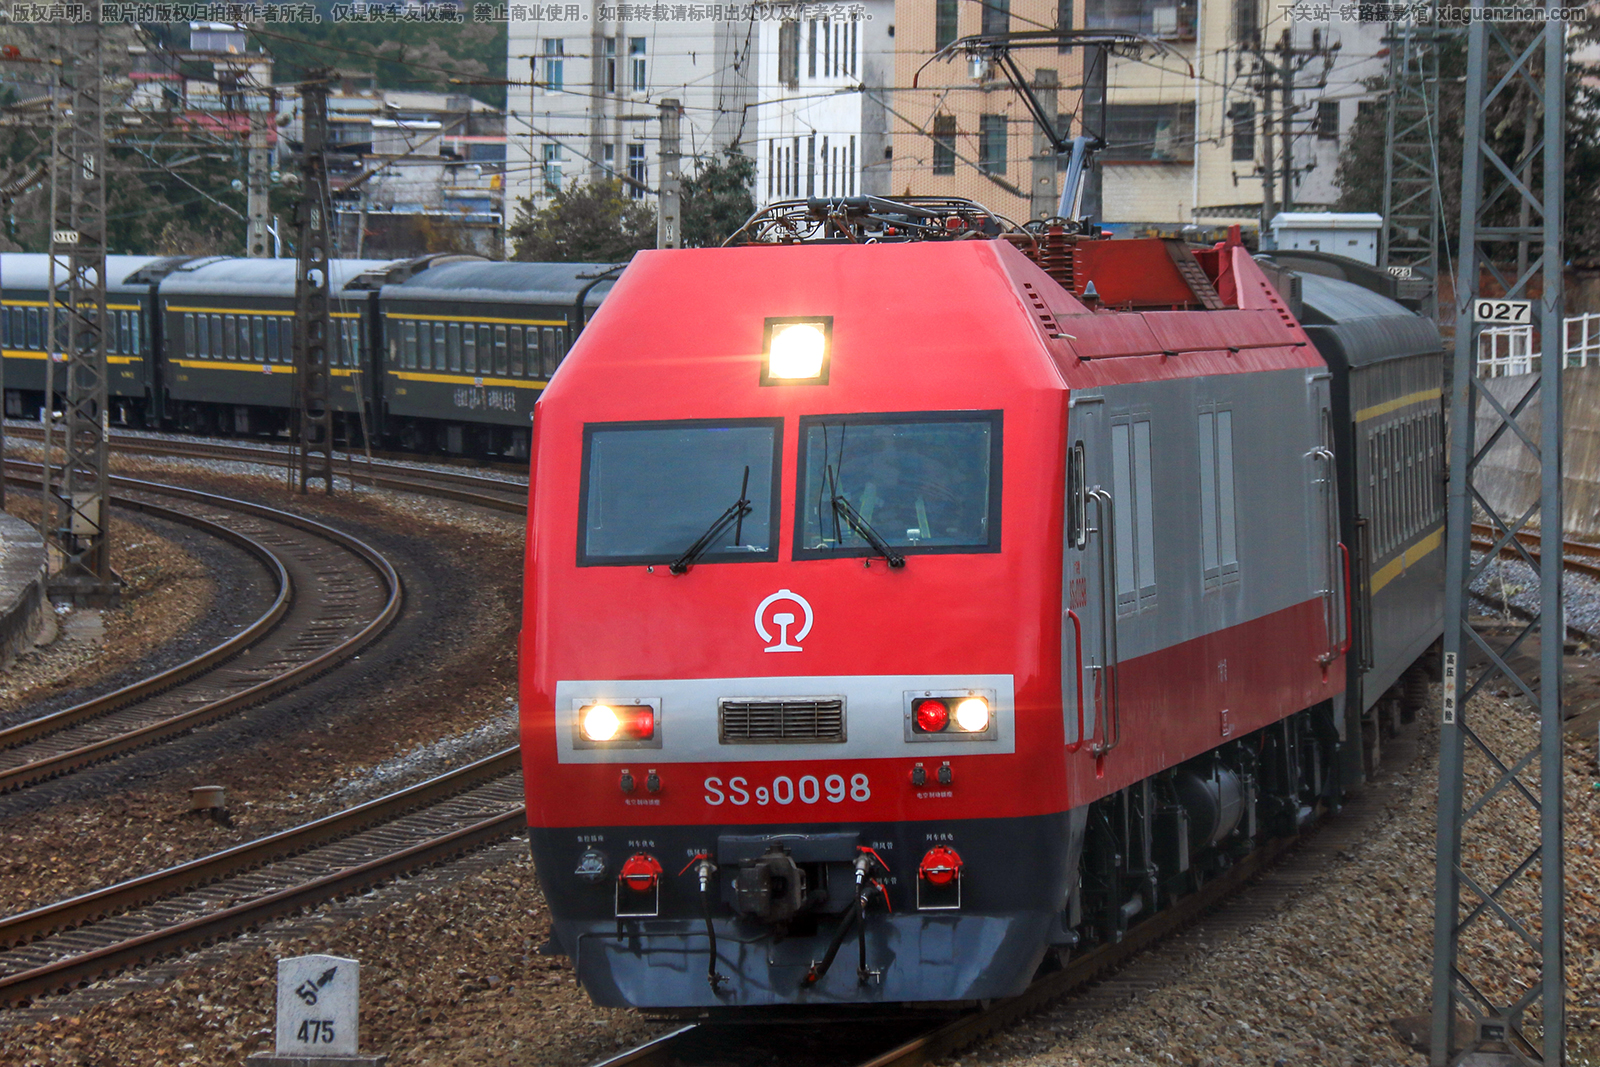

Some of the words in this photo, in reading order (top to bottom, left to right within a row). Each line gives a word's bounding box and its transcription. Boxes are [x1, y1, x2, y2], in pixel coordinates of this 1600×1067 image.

[1478, 302, 1529, 321] 027
[1446, 654, 1455, 677] 高压
[1445, 698, 1454, 721] 危险
[297, 1020, 335, 1044] 475
